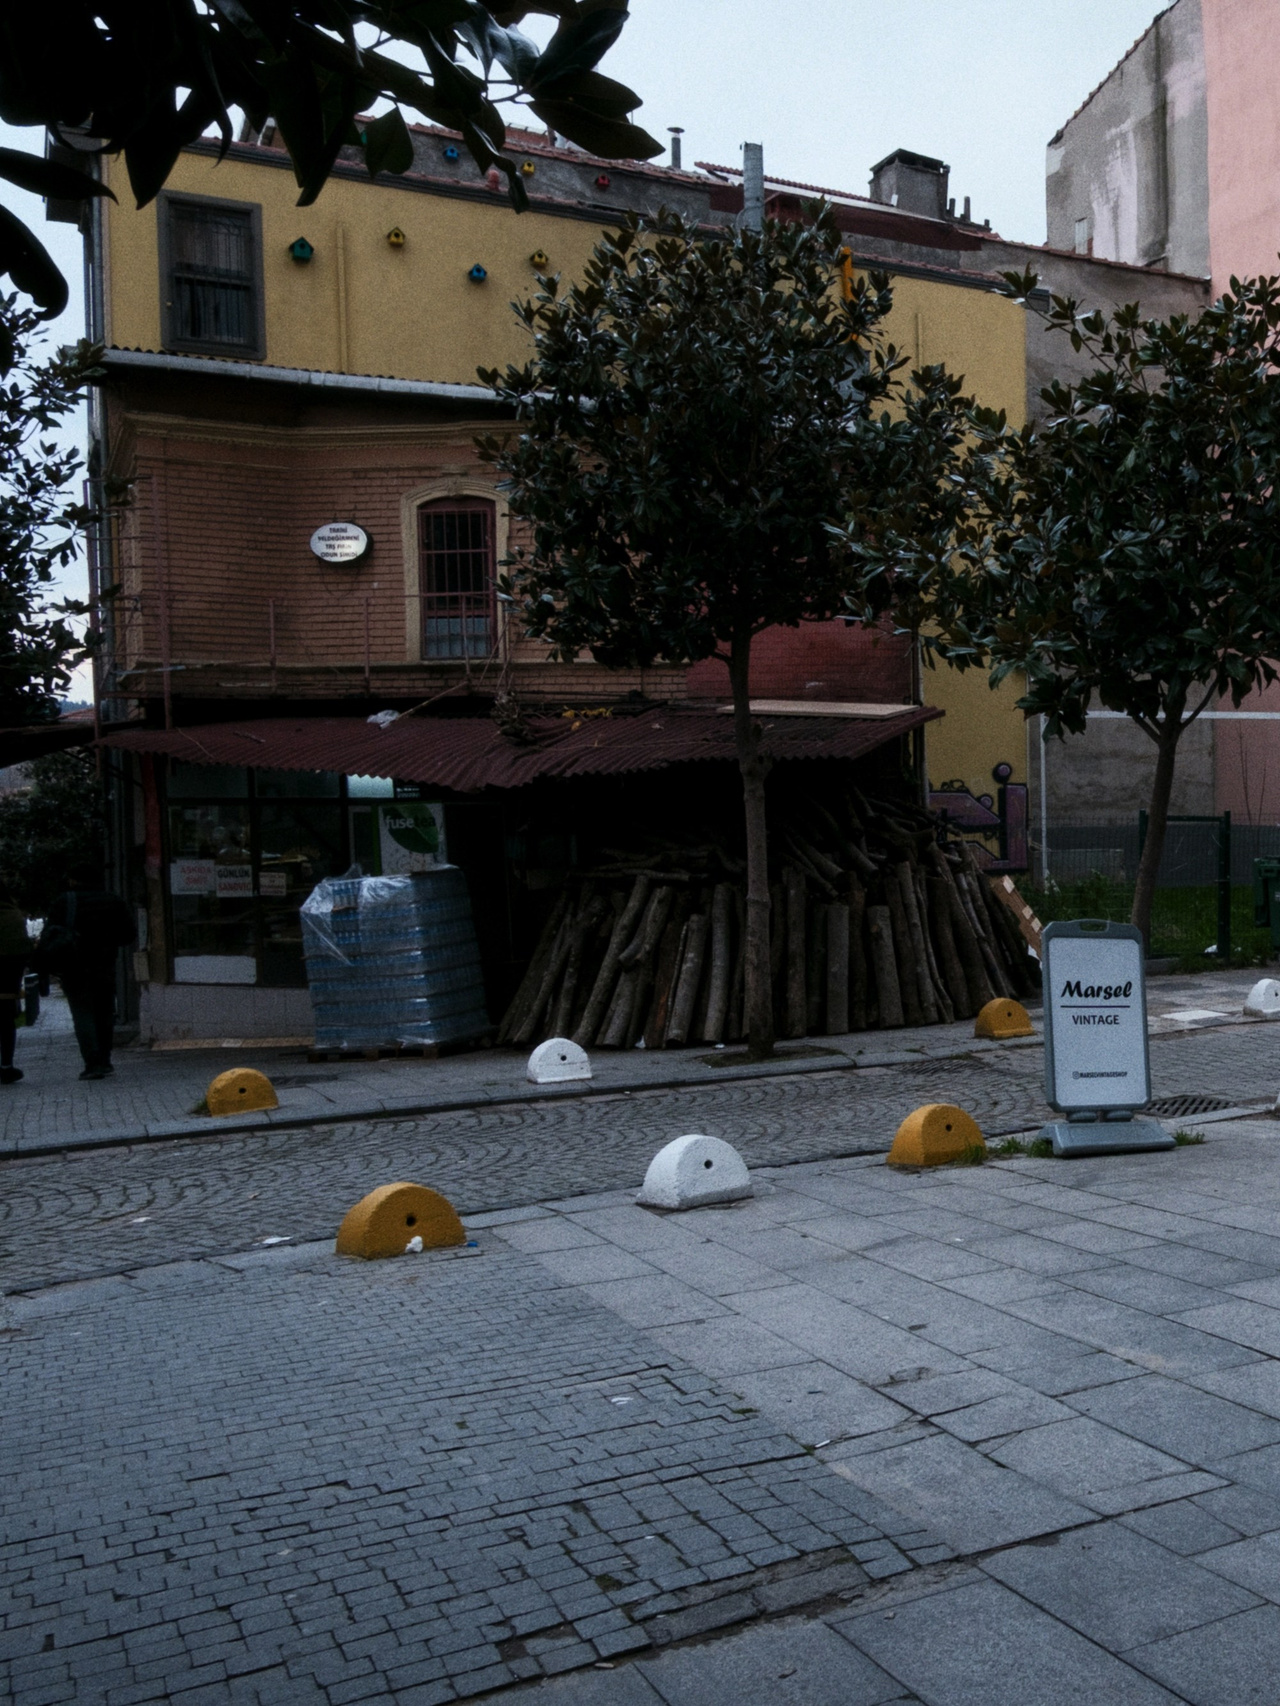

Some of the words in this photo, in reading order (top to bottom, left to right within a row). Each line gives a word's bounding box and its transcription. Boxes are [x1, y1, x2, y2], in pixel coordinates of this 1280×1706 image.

[217, 867, 251, 878] GÜNLÜK
[1061, 981, 1133, 1000] Marsel
[1072, 1015, 1120, 1025] VINTAGE
